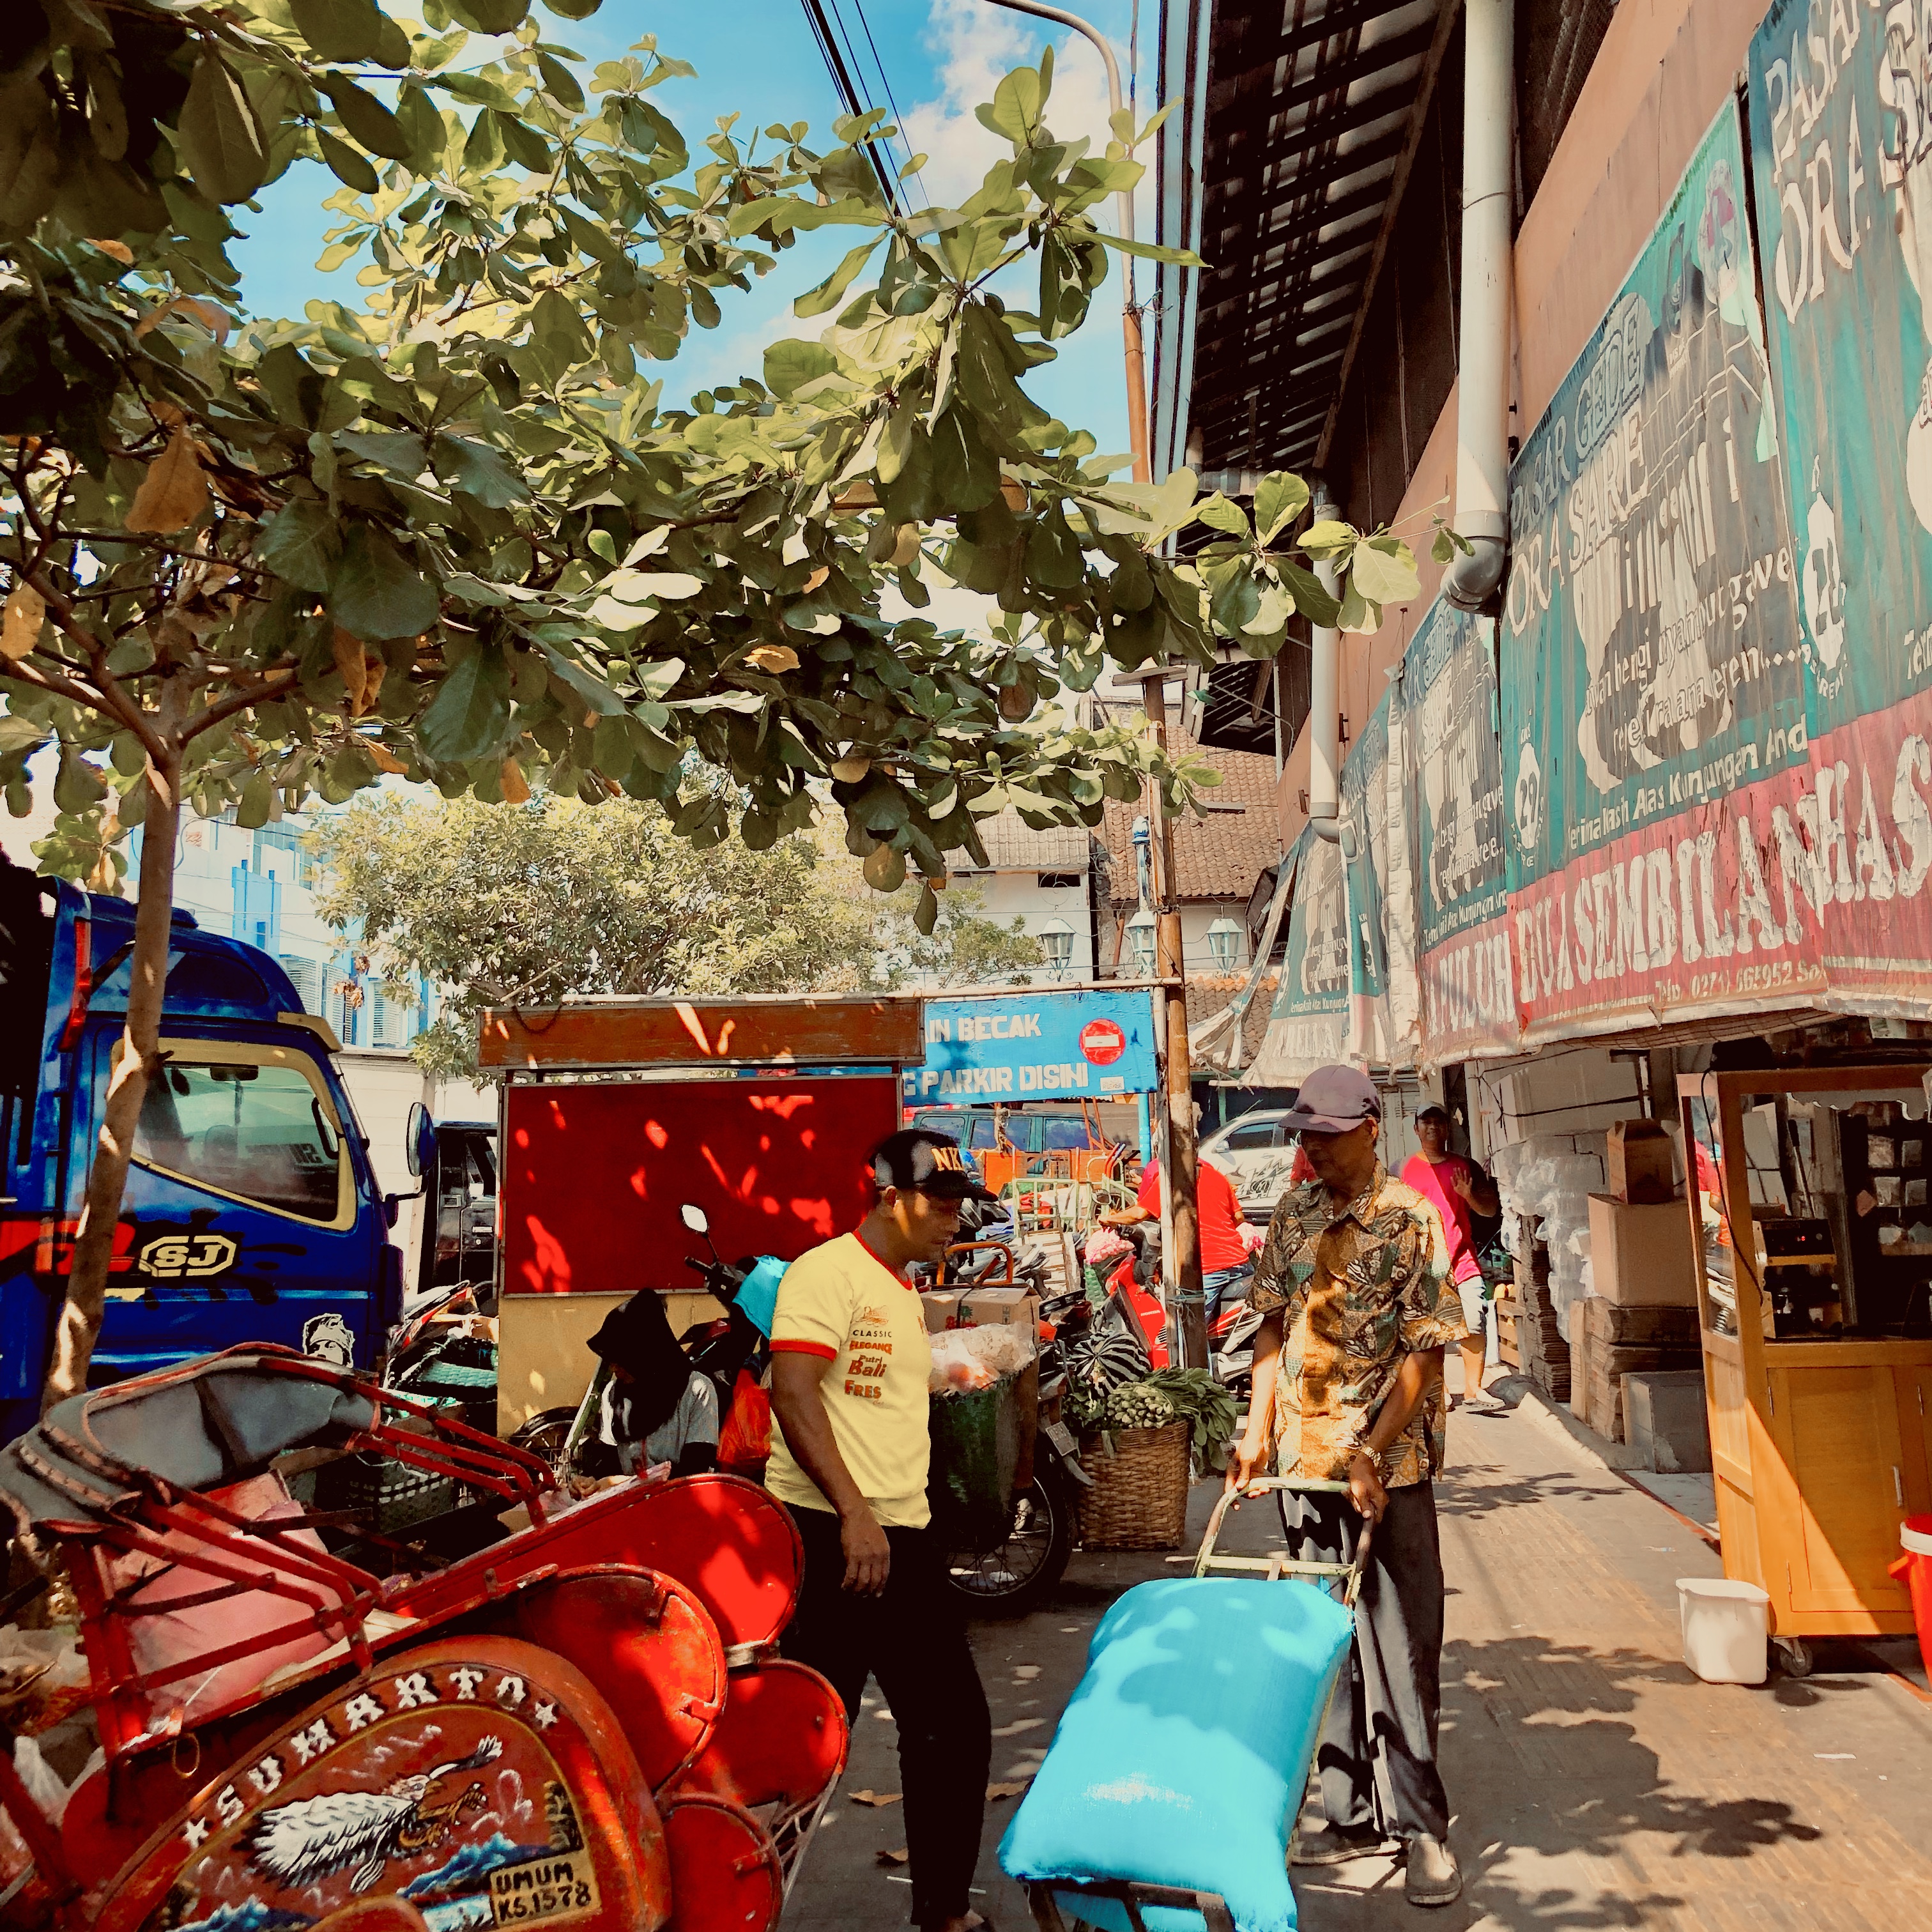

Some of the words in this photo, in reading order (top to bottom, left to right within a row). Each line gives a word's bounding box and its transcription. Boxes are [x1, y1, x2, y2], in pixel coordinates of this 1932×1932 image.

[1574, 305, 1645, 462] GEDE
[1507, 509, 1565, 637] ORA
[1568, 409, 1648, 574] SARE
[958, 1013, 1042, 1042] BECAK
[922, 1066, 1013, 1096] PARKIR
[1019, 1062, 1089, 1091] DISINI
[153, 1245, 222, 1268] SJ
[852, 1330, 893, 1338] CLASSIC
[849, 1340, 893, 1355] ELEGANCE
[858, 1354, 883, 1363] Putri
[847, 1360, 887, 1377] Bali
[844, 1379, 882, 1399] FRES
[496, 1862, 574, 1895] UMUM
